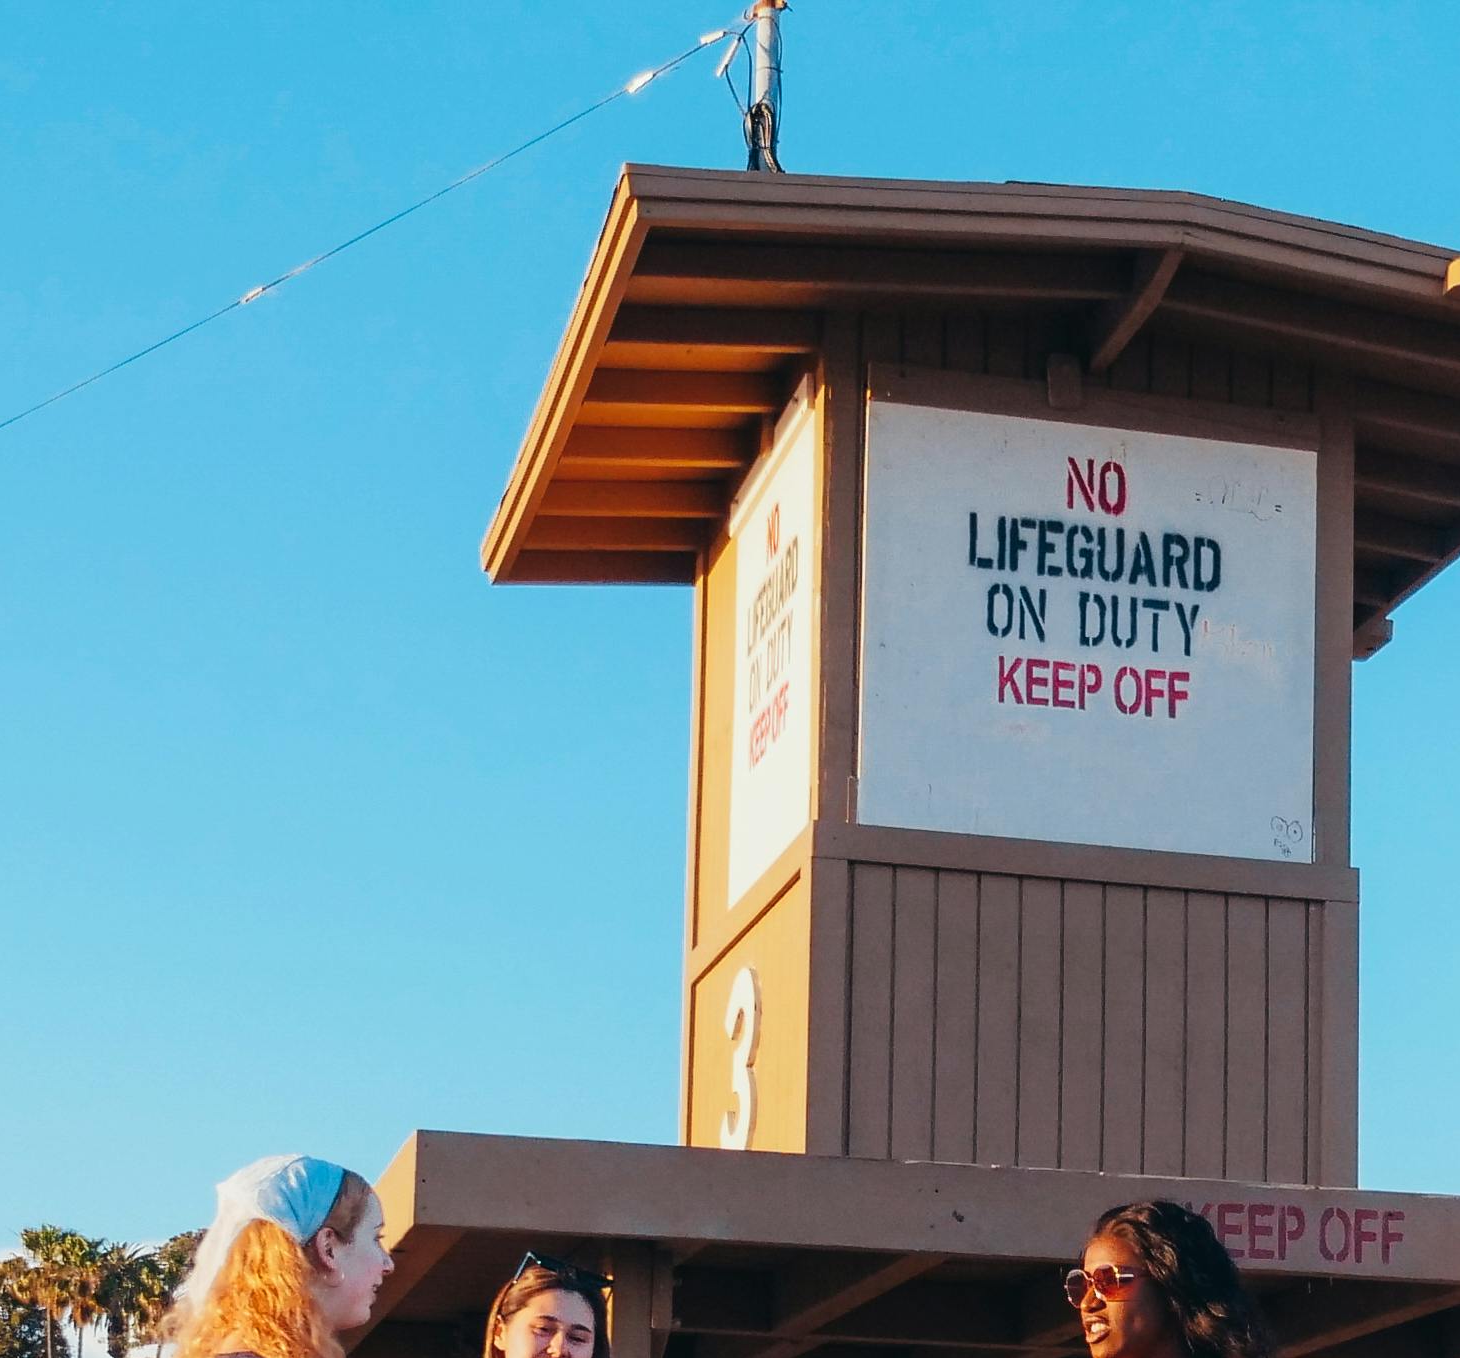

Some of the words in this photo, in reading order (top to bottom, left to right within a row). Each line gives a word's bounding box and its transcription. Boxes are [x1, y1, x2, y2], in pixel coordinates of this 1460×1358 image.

[1066, 456, 1127, 516] NO
[766, 503, 780, 566] NO
[968, 512, 1222, 592] LIFEGUARD
[748, 535, 798, 656] LIFEGUARD
[987, 584, 1046, 642] ON
[1079, 591, 1200, 656] DUTY
[749, 653, 763, 713] ON
[767, 608, 793, 691] DUTY
[998, 656, 1102, 710] KEEP
[1114, 666, 1190, 718] OFF
[749, 703, 771, 773] KEEP
[772, 680, 790, 743] OFF
[720, 966, 761, 1150] 3
[1319, 1207, 1405, 1264] OFF
